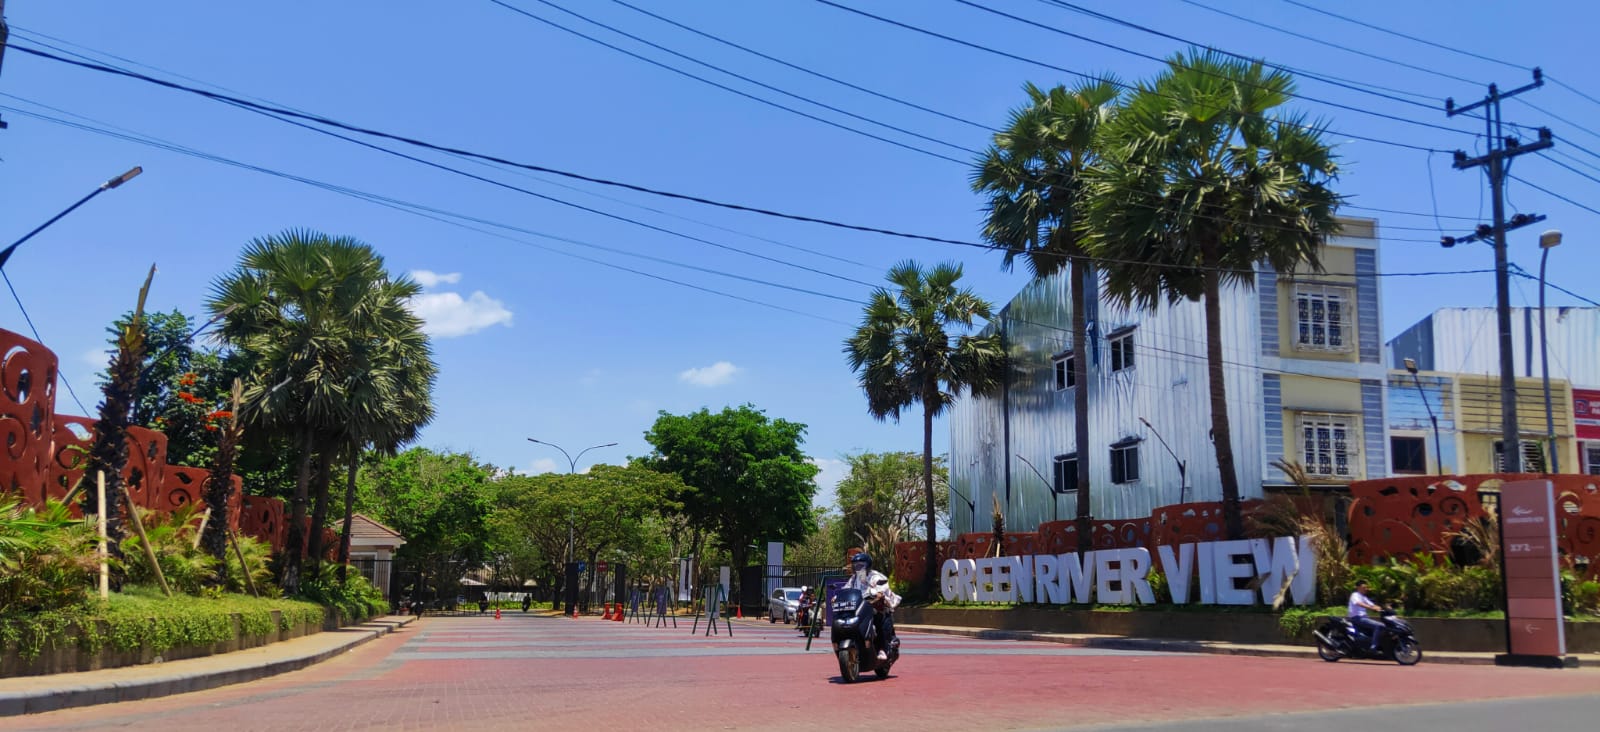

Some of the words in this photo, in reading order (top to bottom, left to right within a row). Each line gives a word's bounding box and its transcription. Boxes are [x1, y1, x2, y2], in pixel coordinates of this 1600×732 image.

[941, 554, 1033, 603] GREEN
[1034, 547, 1156, 604] RIVER
[1157, 535, 1318, 605] VIEW
